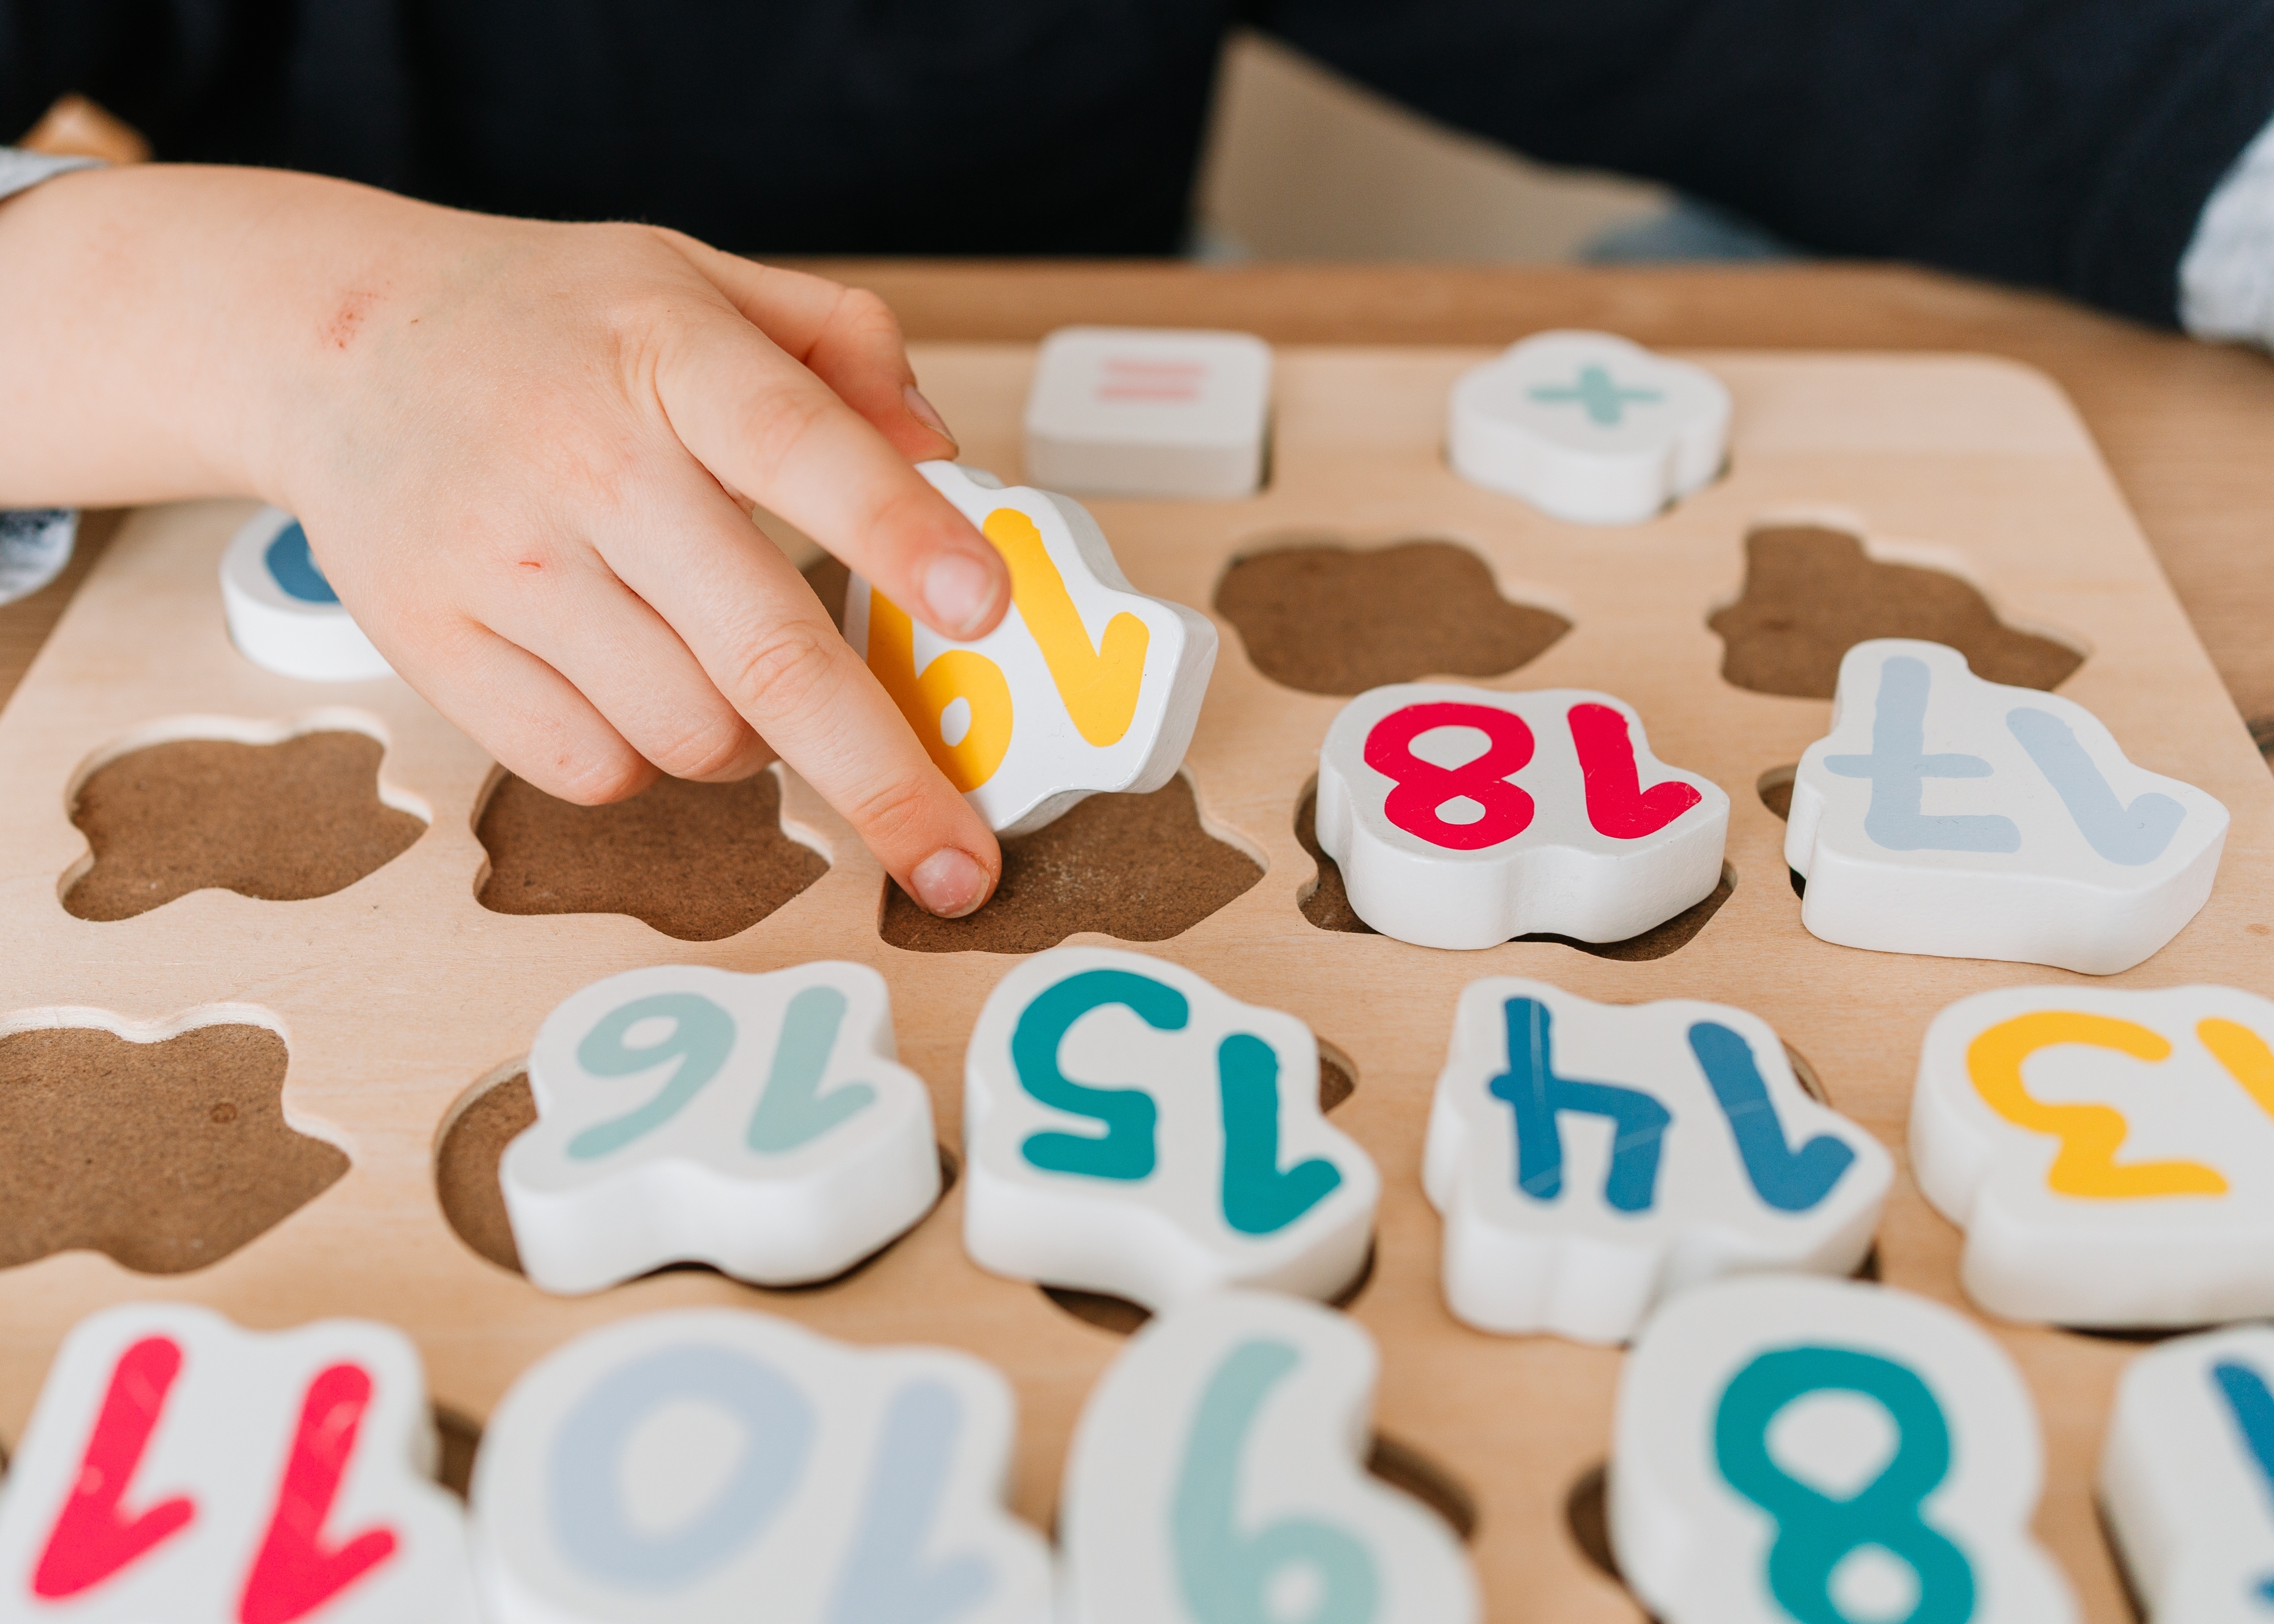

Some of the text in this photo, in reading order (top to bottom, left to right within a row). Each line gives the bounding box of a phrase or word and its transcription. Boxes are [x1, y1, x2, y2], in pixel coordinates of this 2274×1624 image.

[1363, 700, 1703, 852] 18
[1823, 656, 2188, 866] 17
[565, 986, 877, 1162] 16
[1009, 967, 1345, 1239] 15
[1487, 996, 1858, 1216] 14
[27, 1333, 402, 1624] 11
[543, 1344, 999, 1624] 10
[1709, 1341, 1982, 1624] 8
